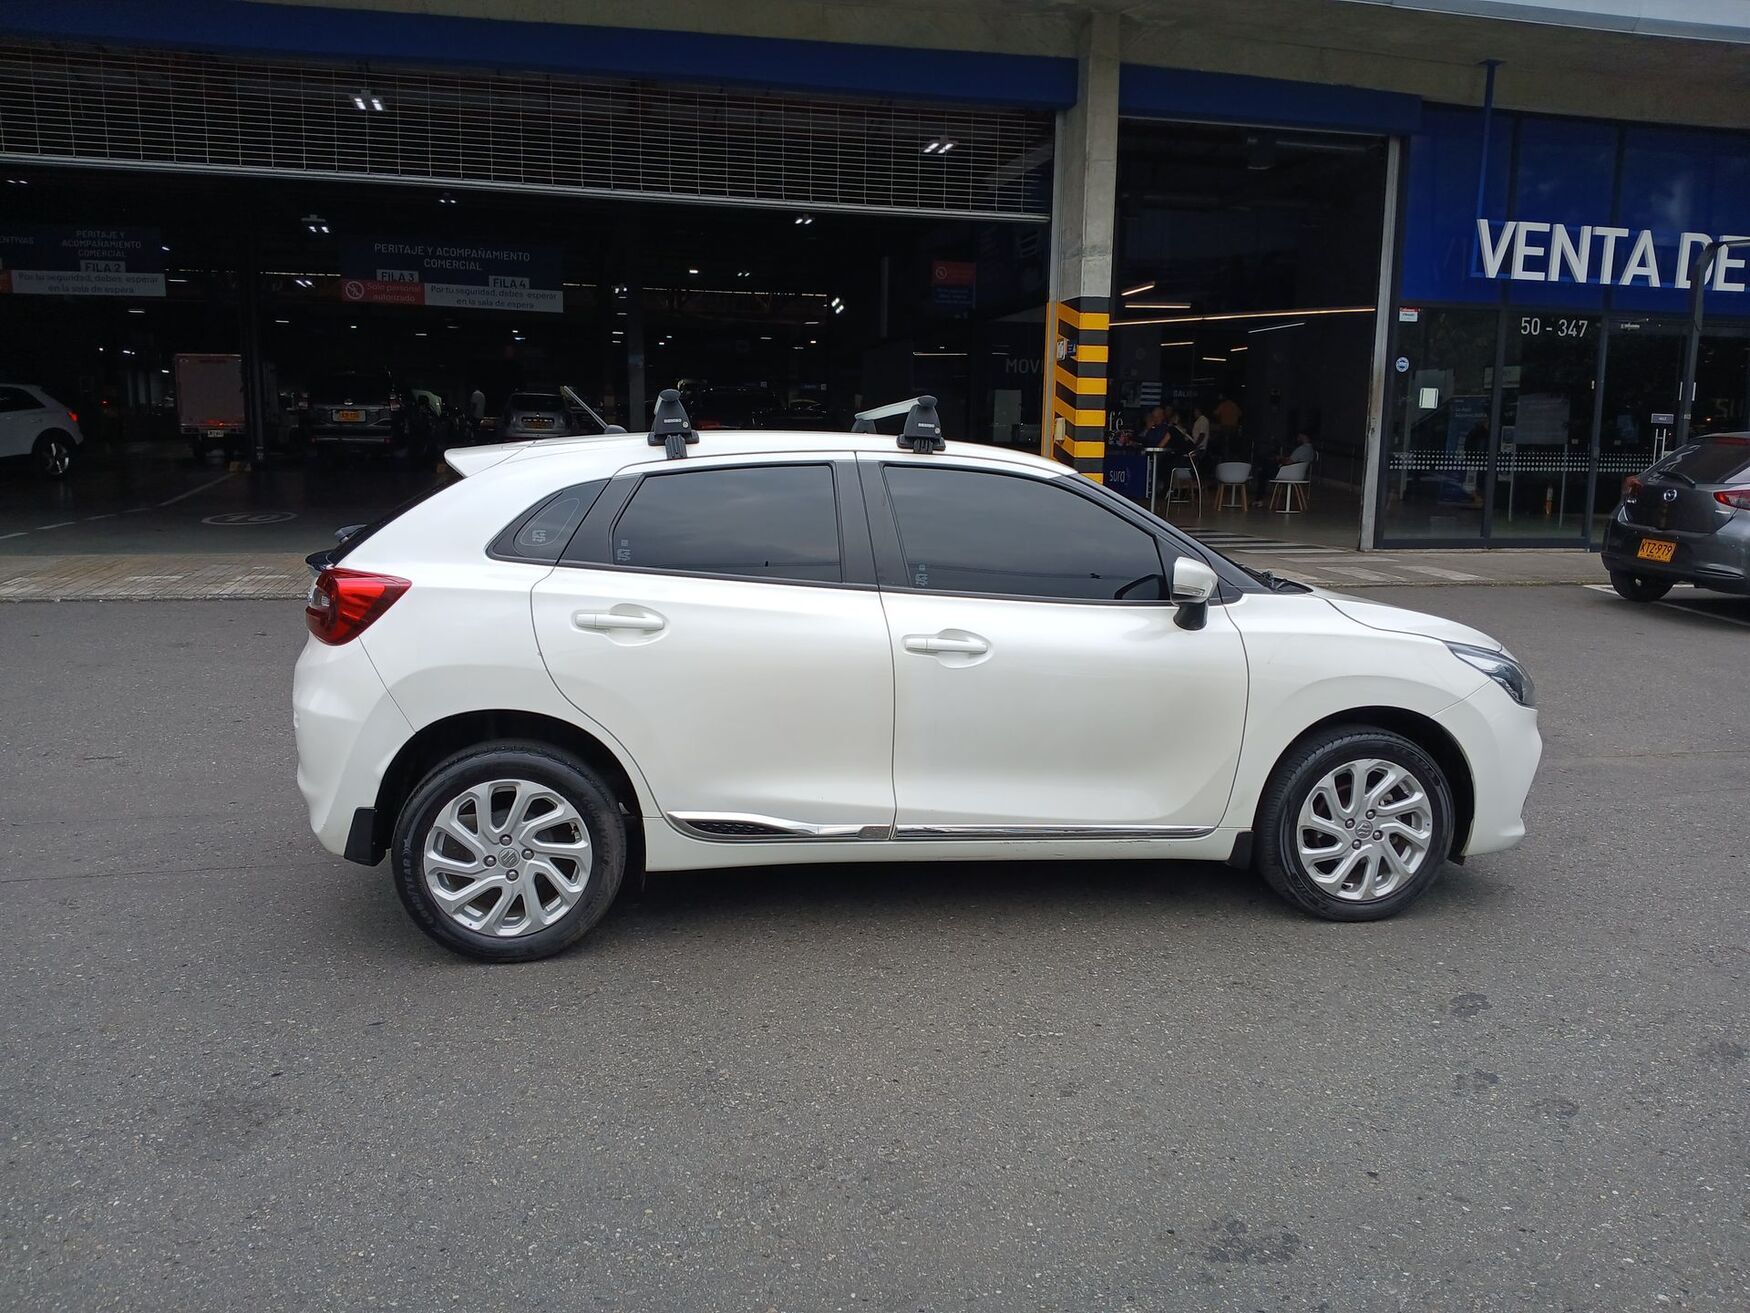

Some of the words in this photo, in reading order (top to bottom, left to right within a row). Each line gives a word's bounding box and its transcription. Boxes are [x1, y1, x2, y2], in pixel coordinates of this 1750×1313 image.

[76, 230, 118, 240] PERITAJE
[78, 249, 127, 258] COMERCIAL
[374, 243, 424, 256] PERITAJE
[426, 246, 433, 256] Y
[436, 247, 530, 262] ACOMPAÑAMIENTO
[1477, 218, 1661, 288] VENTA
[1674, 232, 1750, 292] DE
[84, 263, 111, 273] FILA
[113, 263, 122, 273] 2
[423, 258, 482, 271] COMERCIAL
[381, 271, 406, 282] FILA
[408, 272, 416, 282] 3
[493, 278, 517, 289] FILA
[519, 280, 527, 289] 4
[430, 285, 445, 294] Por
[526, 292, 557, 302] esperar
[477, 299, 494, 307] sala
[508, 301, 534, 310] espera
[1520, 317, 1541, 335] 50
[1557, 319, 1588, 338] 347
[1109, 470, 1126, 483] sura
